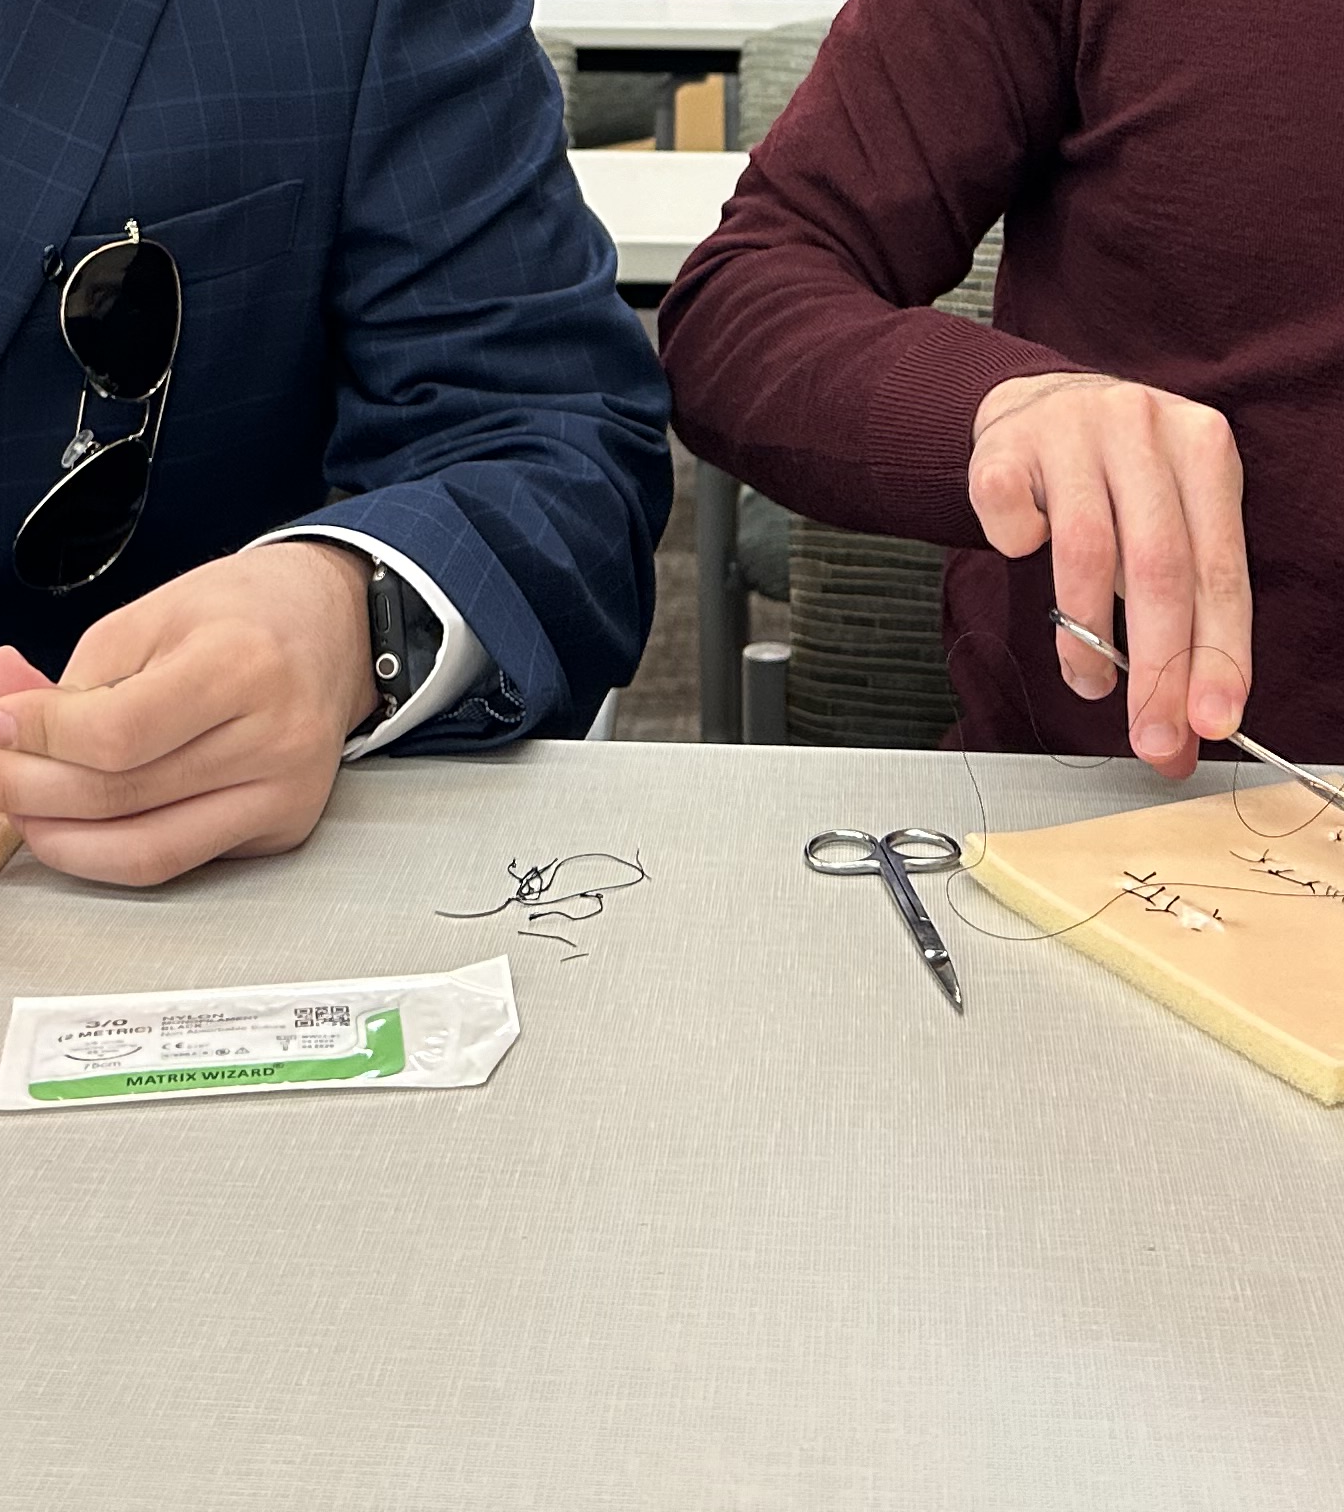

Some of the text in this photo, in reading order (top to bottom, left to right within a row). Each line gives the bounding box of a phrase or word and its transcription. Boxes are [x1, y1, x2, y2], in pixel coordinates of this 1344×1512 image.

[162, 1013, 225, 1022] NYLON
[126, 1066, 276, 1087] MATRIX WIZARD
